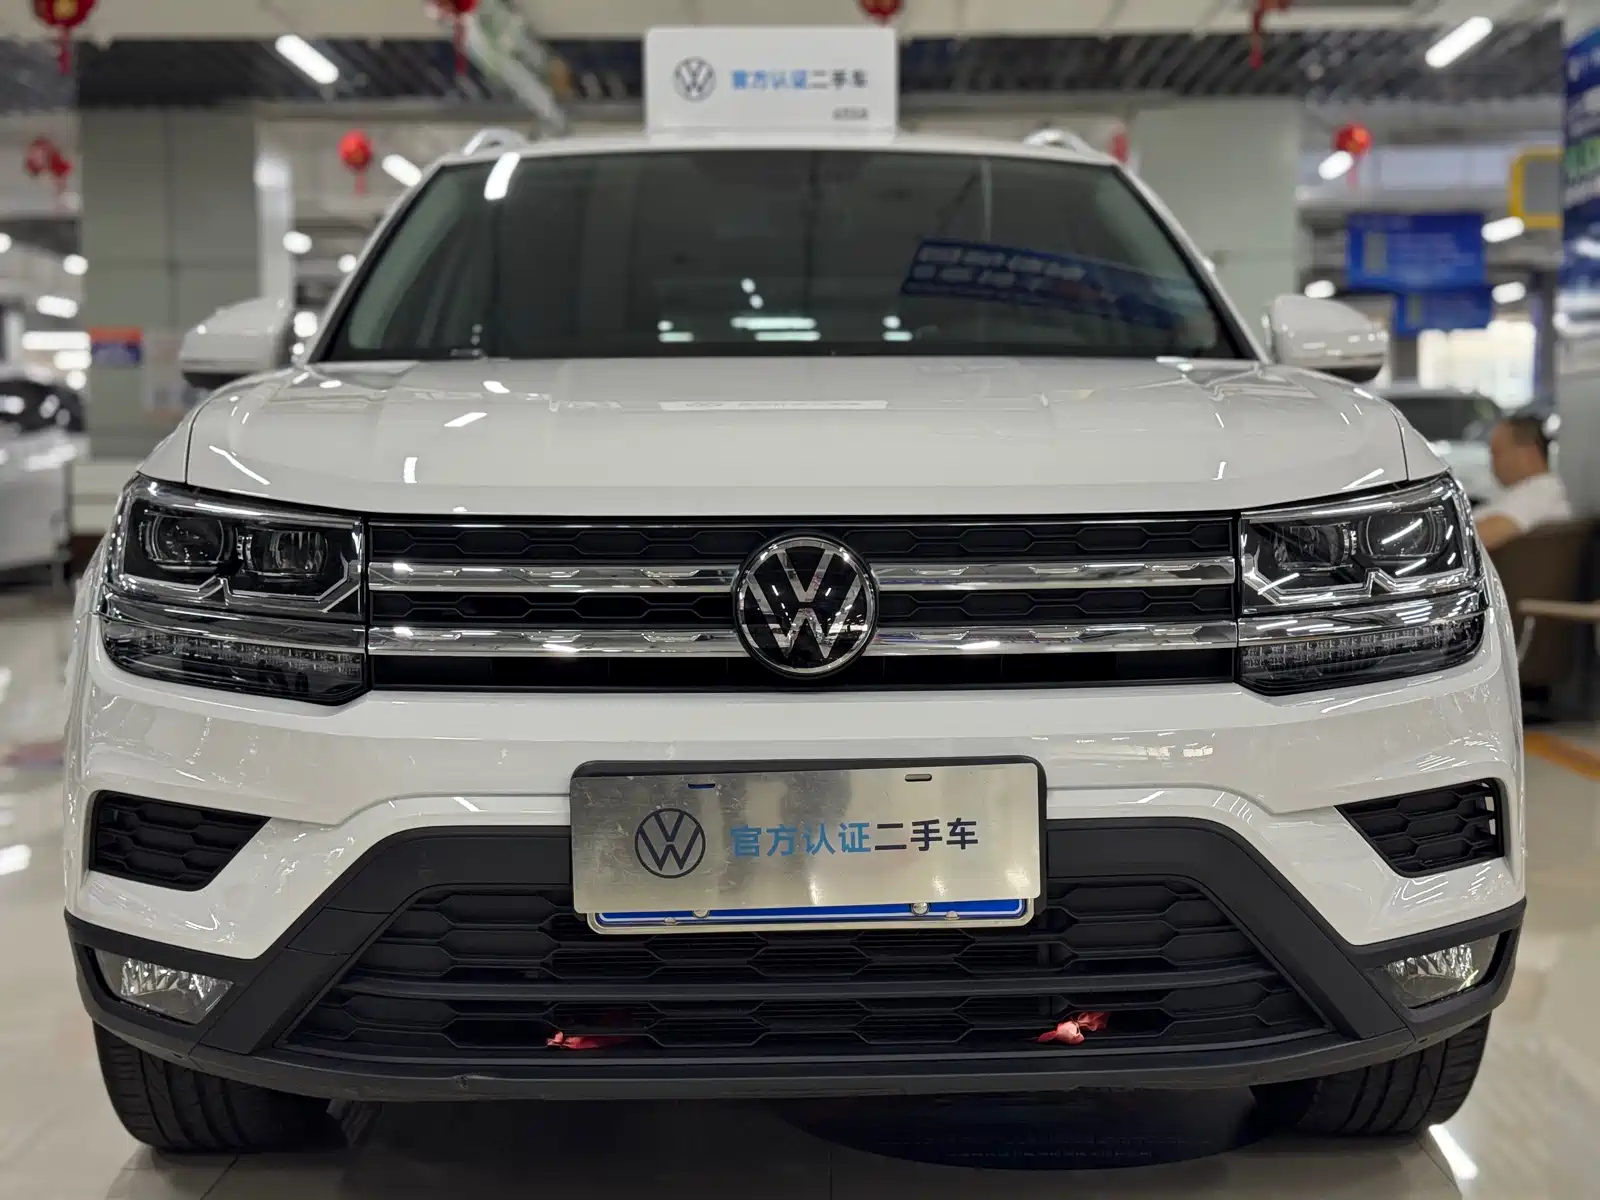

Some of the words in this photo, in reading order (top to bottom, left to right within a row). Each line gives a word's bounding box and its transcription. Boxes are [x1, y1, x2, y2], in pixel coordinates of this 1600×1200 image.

[746, 543, 866, 661] VW
[636, 809, 705, 877] VW
[730, 818, 979, 858] 官方认证二手车
